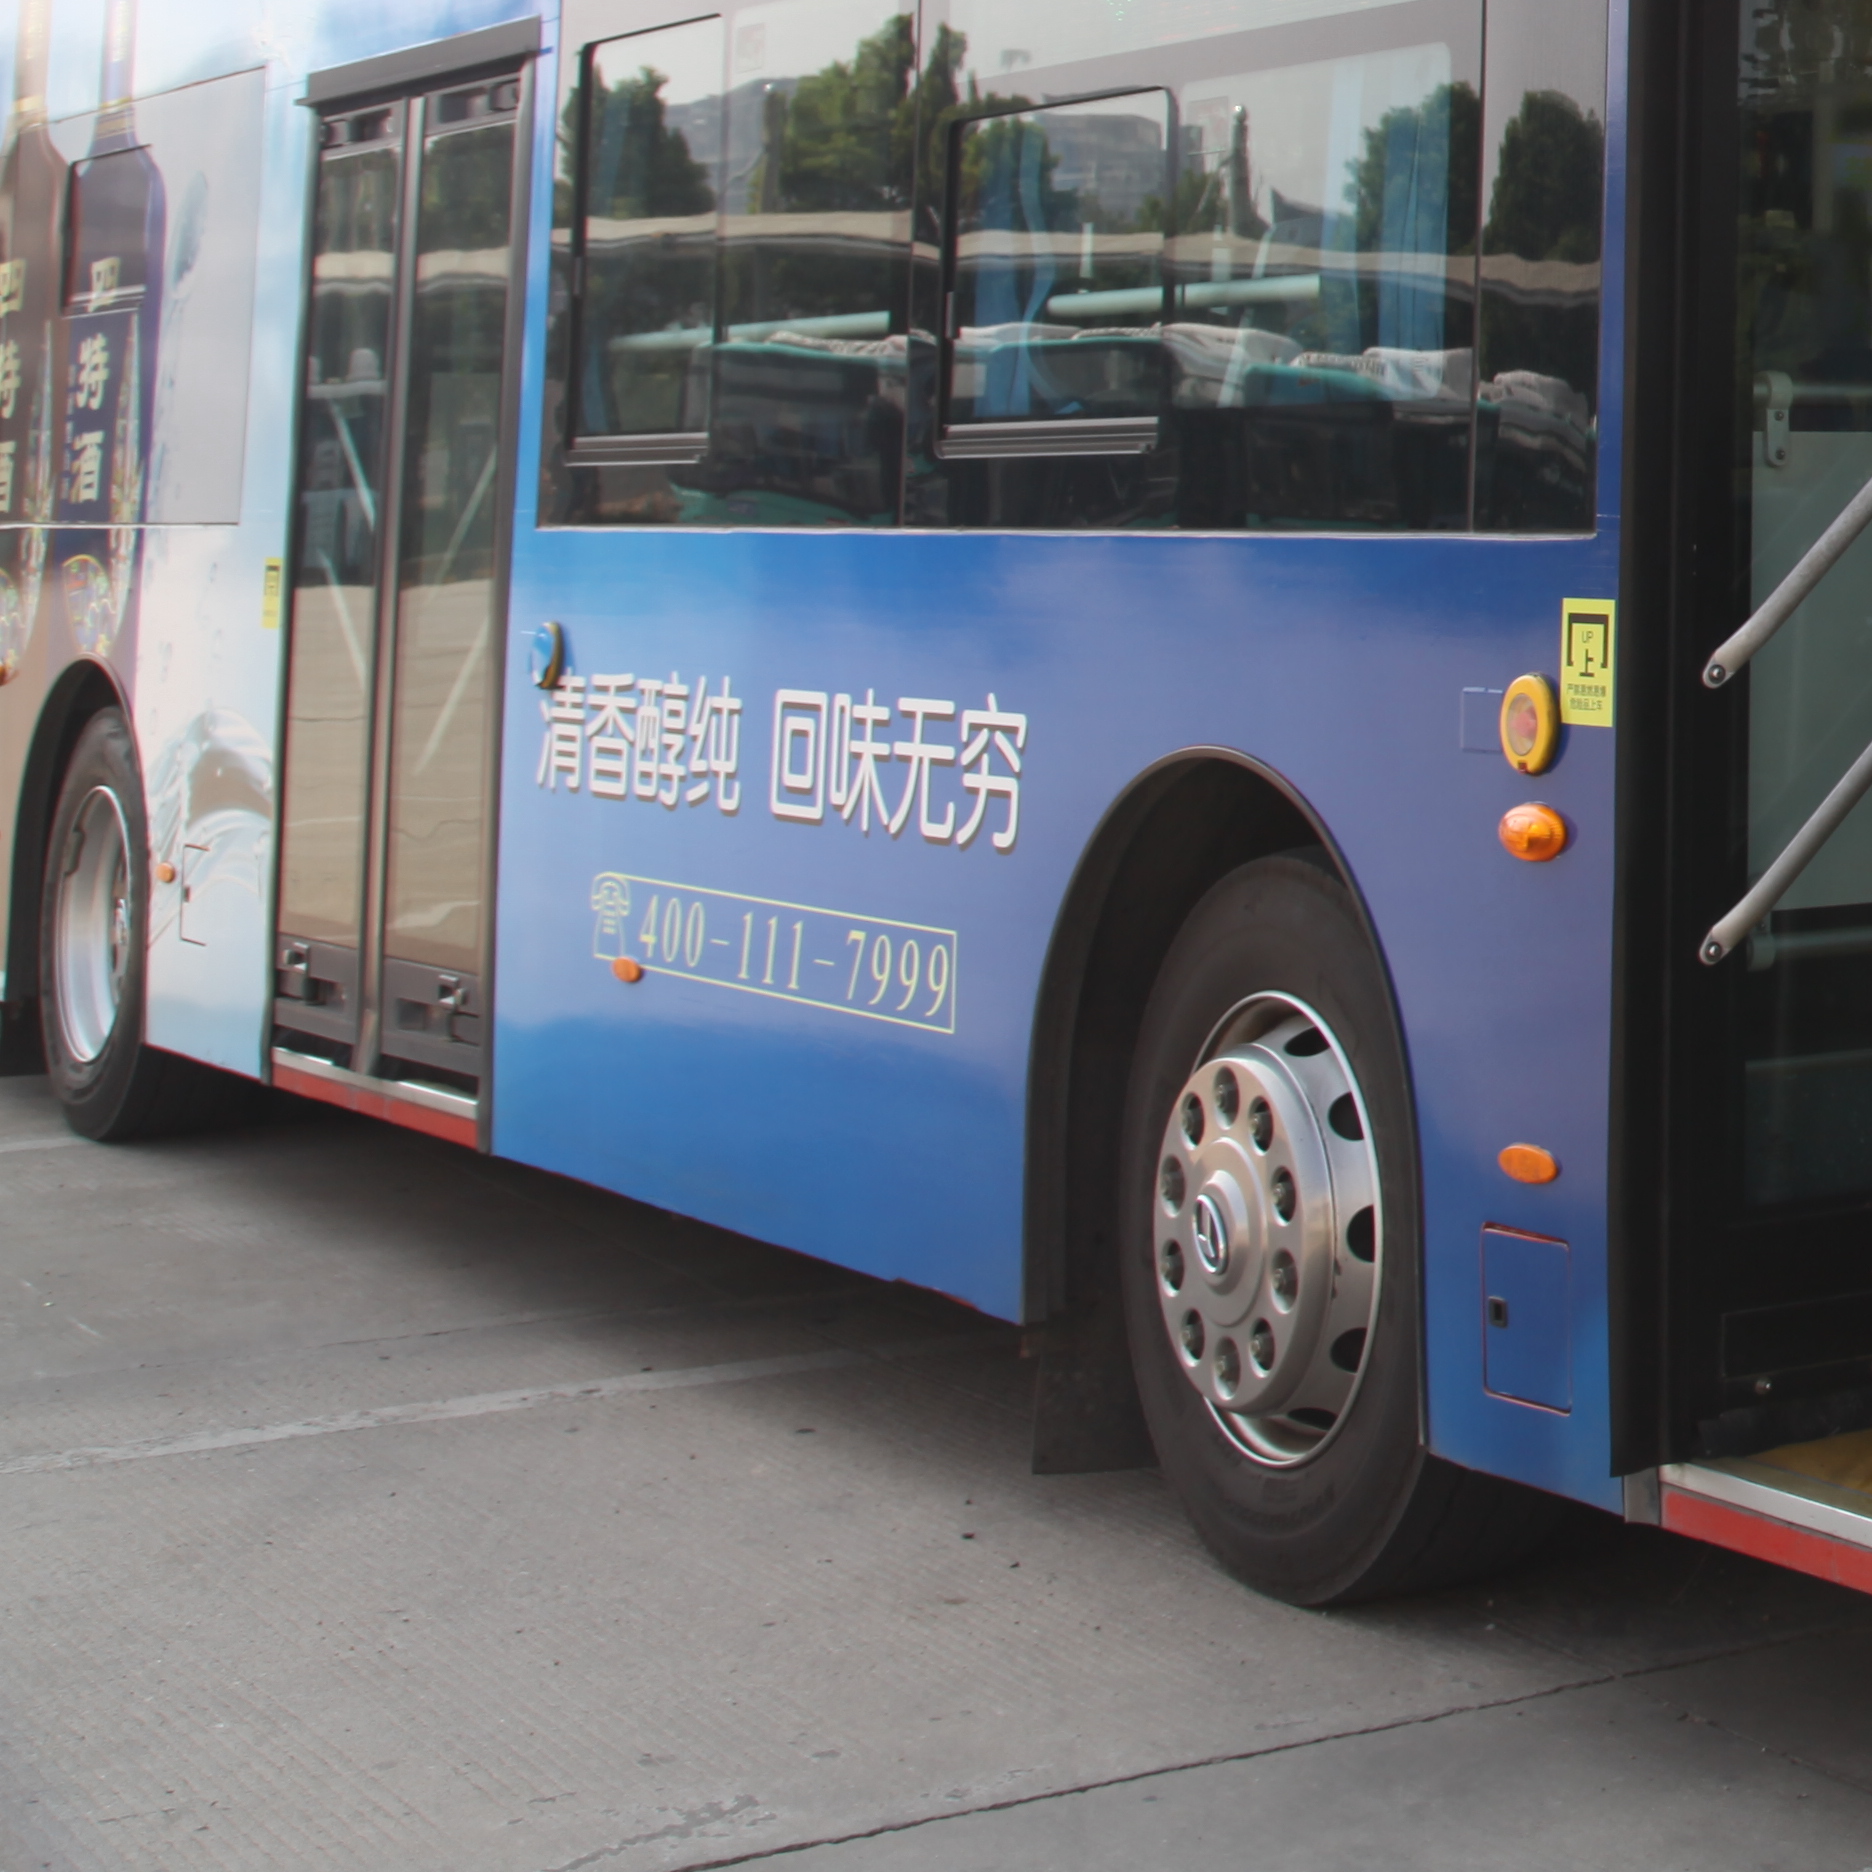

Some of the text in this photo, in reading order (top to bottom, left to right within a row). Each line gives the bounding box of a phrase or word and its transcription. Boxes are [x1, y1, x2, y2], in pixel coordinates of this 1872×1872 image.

[1579, 648, 1595, 677] 上
[1581, 630, 1594, 643] UP
[536, 668, 742, 812] 清香醇纯
[769, 688, 1028, 849] 回味无穷
[640, 895, 950, 1017] 400-111-7999
